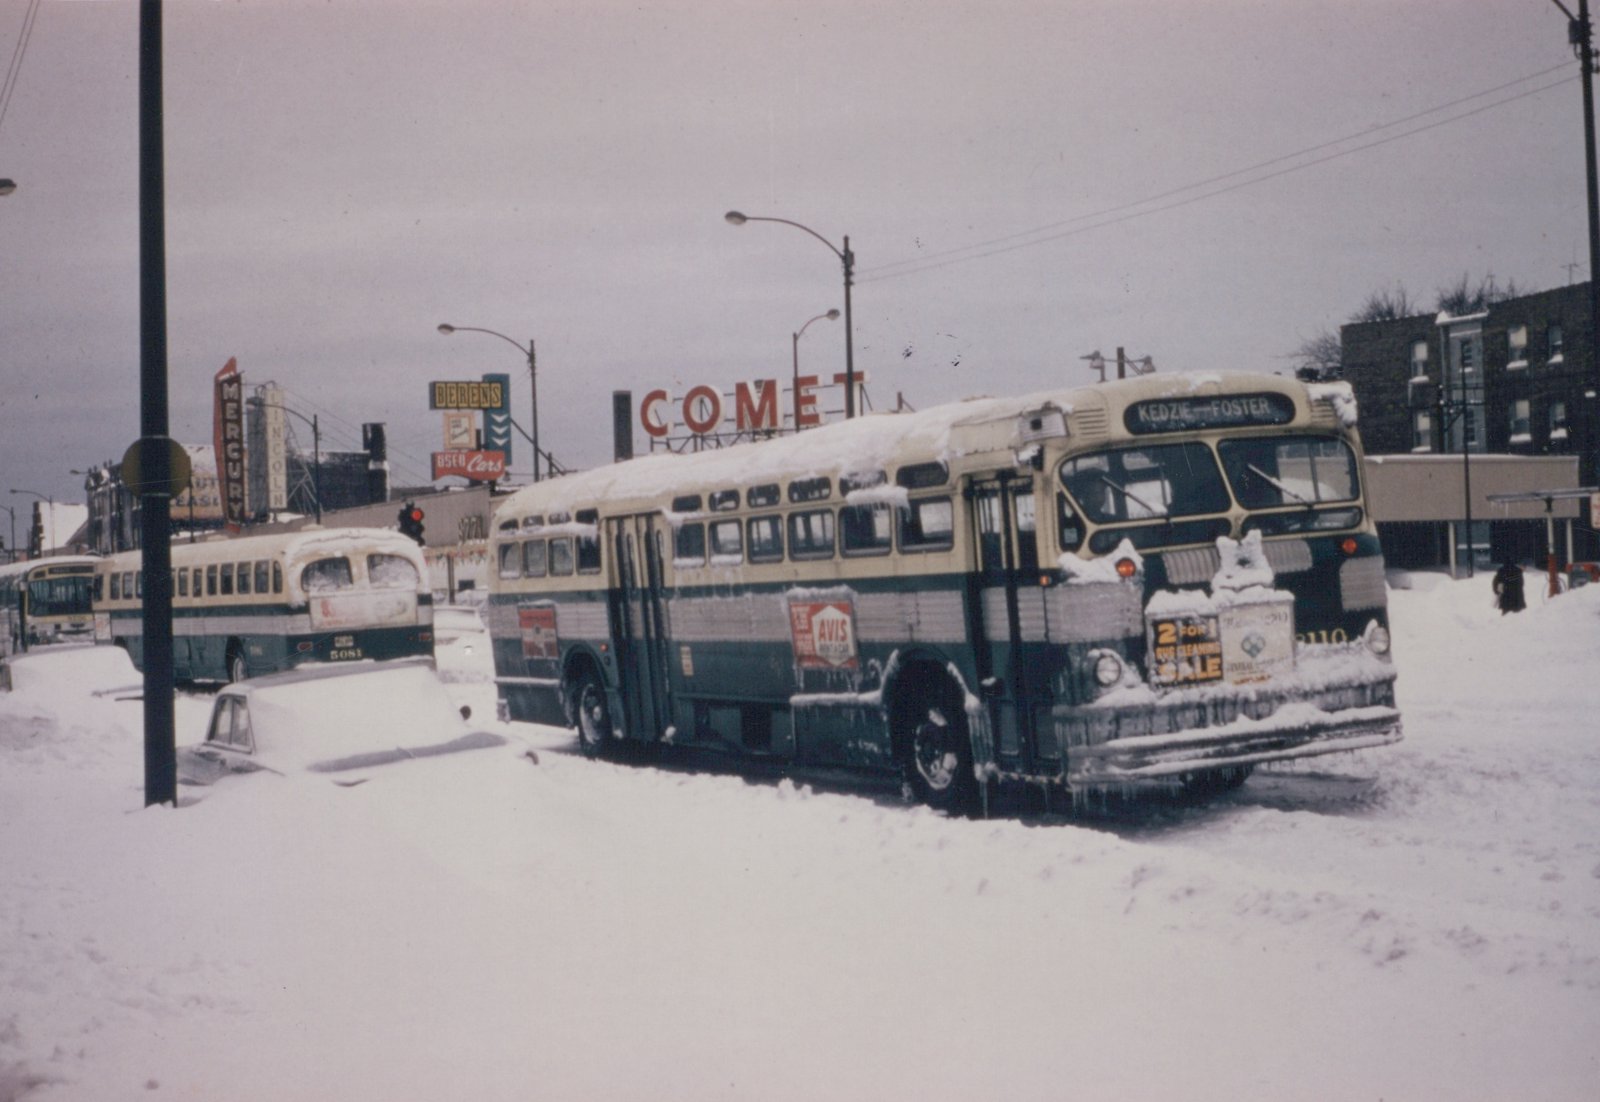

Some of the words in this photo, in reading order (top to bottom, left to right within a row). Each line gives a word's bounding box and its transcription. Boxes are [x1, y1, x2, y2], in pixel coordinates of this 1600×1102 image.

[435, 383, 502, 408] BERENS
[640, 371, 865, 437] COMET
[1137, 402, 1192, 423] KEDZIE
[1211, 398, 1271, 416] FOSTER
[222, 382, 244, 519] MERCURY
[271, 390, 285, 507] LINCOLN
[466, 454, 502, 473] Cars
[819, 618, 847, 641] AVIS
[1157, 622, 1177, 645] 2
[1179, 624, 1206, 638] FOR
[1156, 656, 1222, 683] SALE
